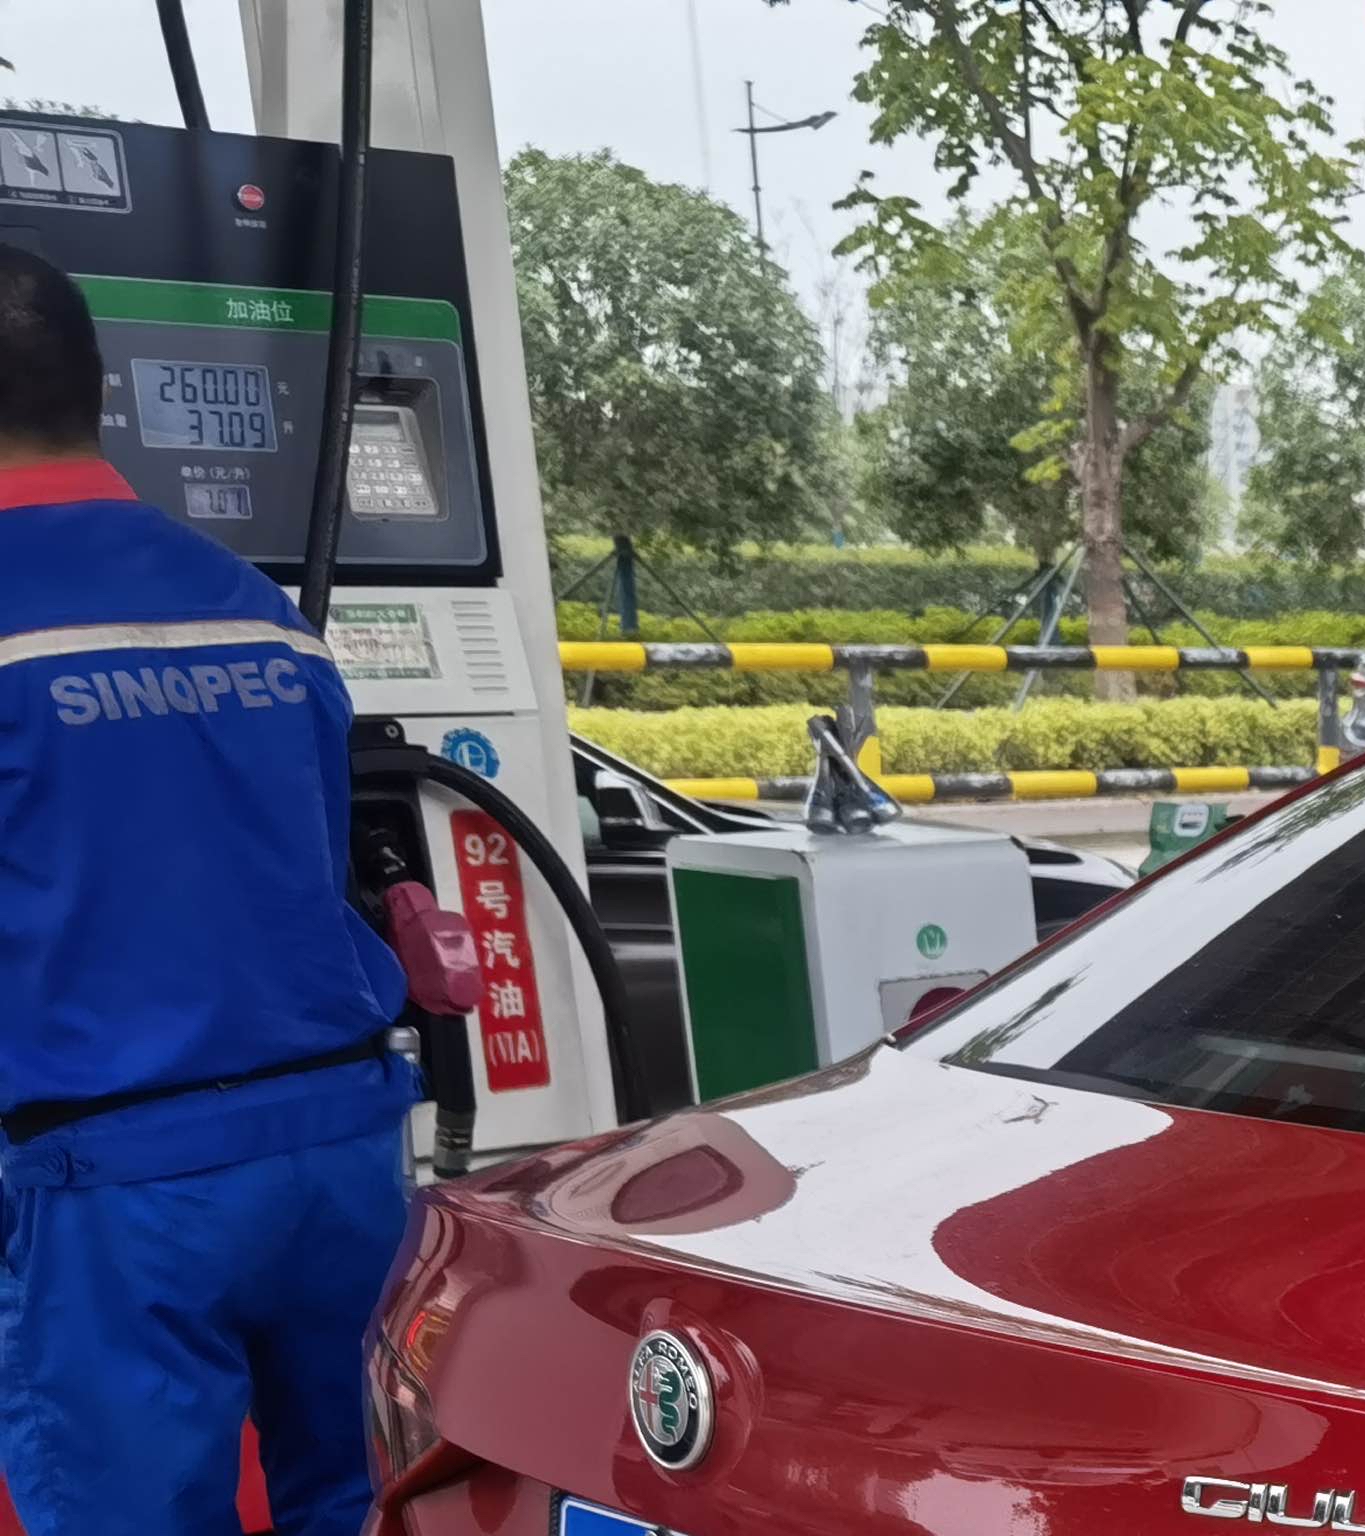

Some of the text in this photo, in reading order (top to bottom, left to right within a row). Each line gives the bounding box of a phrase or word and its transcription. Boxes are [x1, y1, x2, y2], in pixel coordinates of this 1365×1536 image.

[226, 297, 295, 323] 加油位
[49, 657, 308, 726] SINOPEC
[657, 1340, 699, 1411] ROMEO
